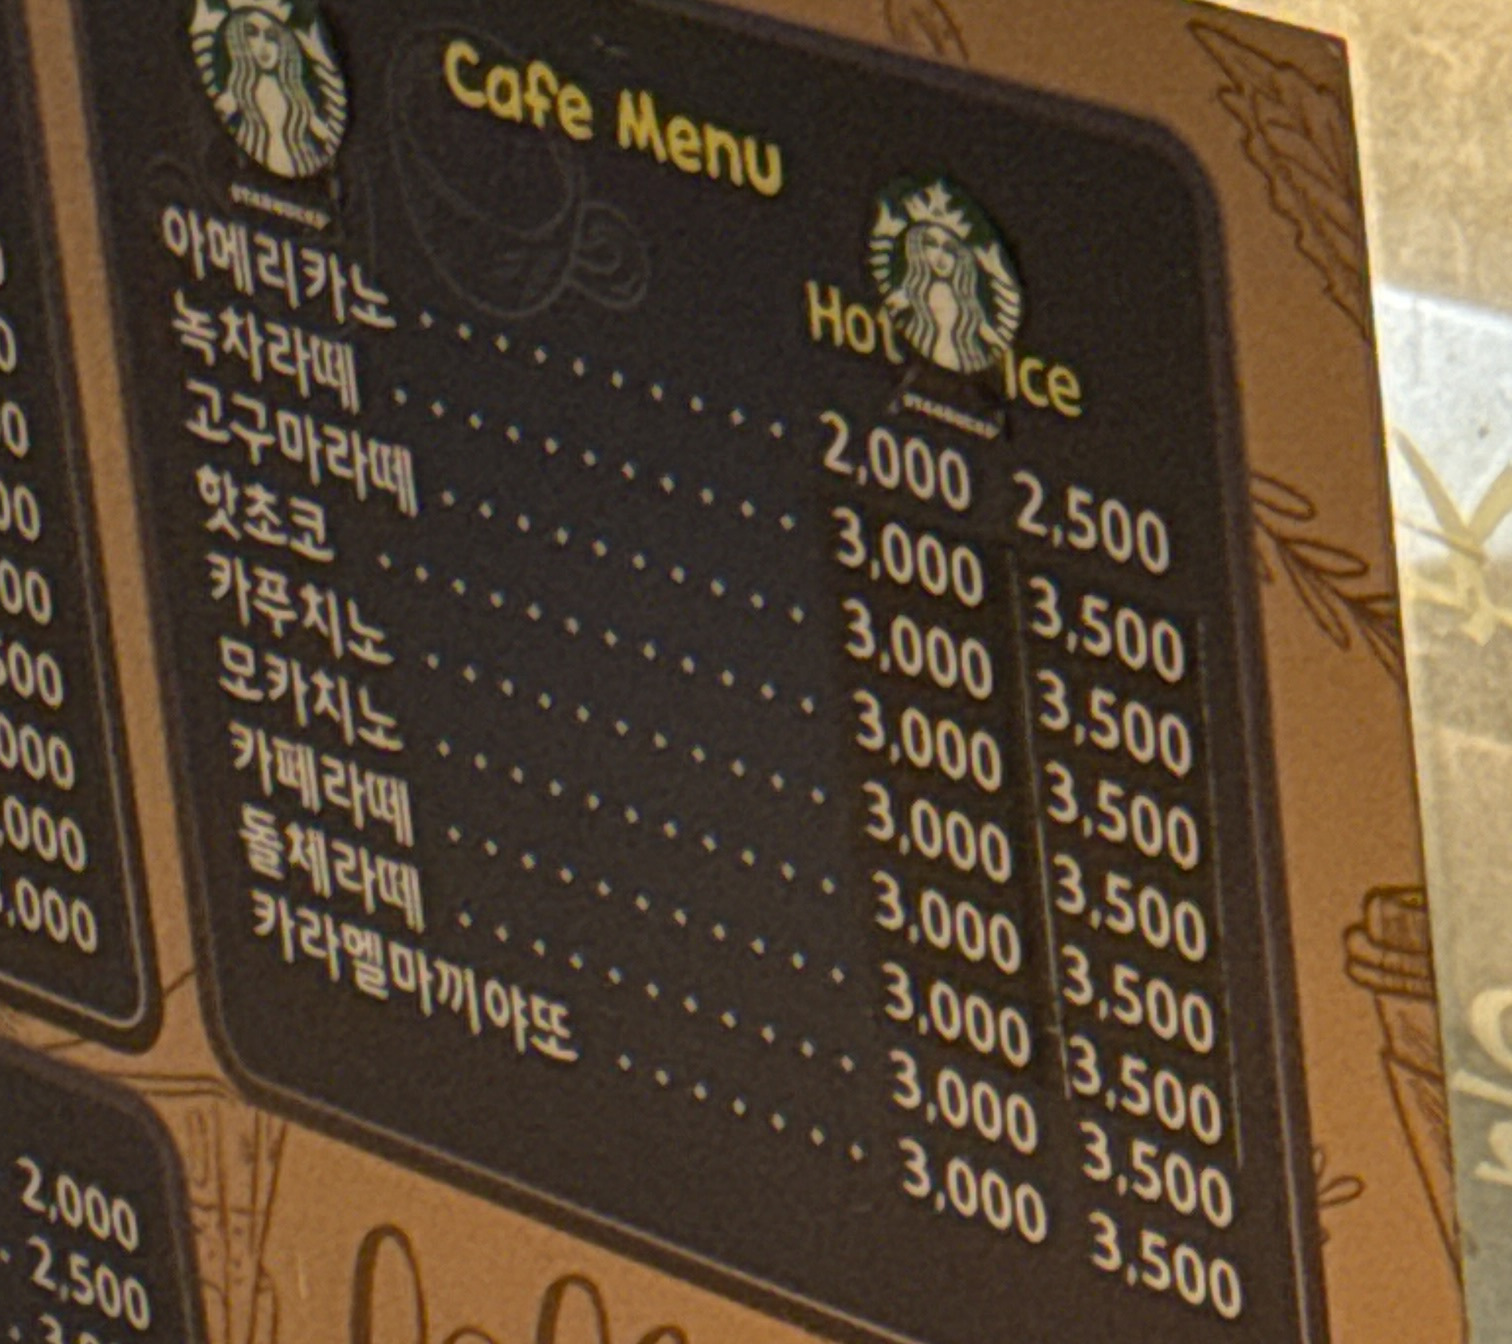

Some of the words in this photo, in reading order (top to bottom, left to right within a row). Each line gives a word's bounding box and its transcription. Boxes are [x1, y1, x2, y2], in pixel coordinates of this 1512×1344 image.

[443, 39, 594, 141] Cafe
[617, 89, 783, 197] Menu
[162, 206, 397, 329] 아메리카노
[821, 413, 970, 510] 2,000
[1015, 472, 1169, 573] 2,500
[172, 289, 360, 415] 녹차라떼
[834, 508, 983, 606] 3,000
[1030, 578, 1184, 681] 3,500
[186, 378, 419, 519] 고구마라떼
[844, 600, 992, 698] 3,000
[1037, 671, 1191, 776] 3,500
[195, 464, 335, 563] 핫초코
[854, 691, 1001, 791] 3,000
[1046, 762, 1198, 869] 3,500
[205, 552, 394, 665] 카푸치노
[864, 782, 1011, 882] 3,000
[1054, 852, 1206, 960] 3,500
[218, 636, 404, 753] 모카치노
[873, 872, 1020, 973] 3,000
[1062, 943, 1213, 1052] 3,500
[228, 720, 415, 848] 카페라떼
[883, 963, 1030, 1066] 3,000
[1069, 1032, 1221, 1143] 3,500
[239, 802, 425, 935] 돌체라떼
[891, 1051, 1037, 1153] 3,000
[1081, 1122, 1232, 1227] 3,500
[251, 887, 579, 1062] 카라멜마끼야또
[900, 1139, 1047, 1242] 3,000
[1090, 1212, 1241, 1318] 3,500
[18, 1157, 138, 1251] 2,000
[29, 1236, 149, 1329] 2,500
